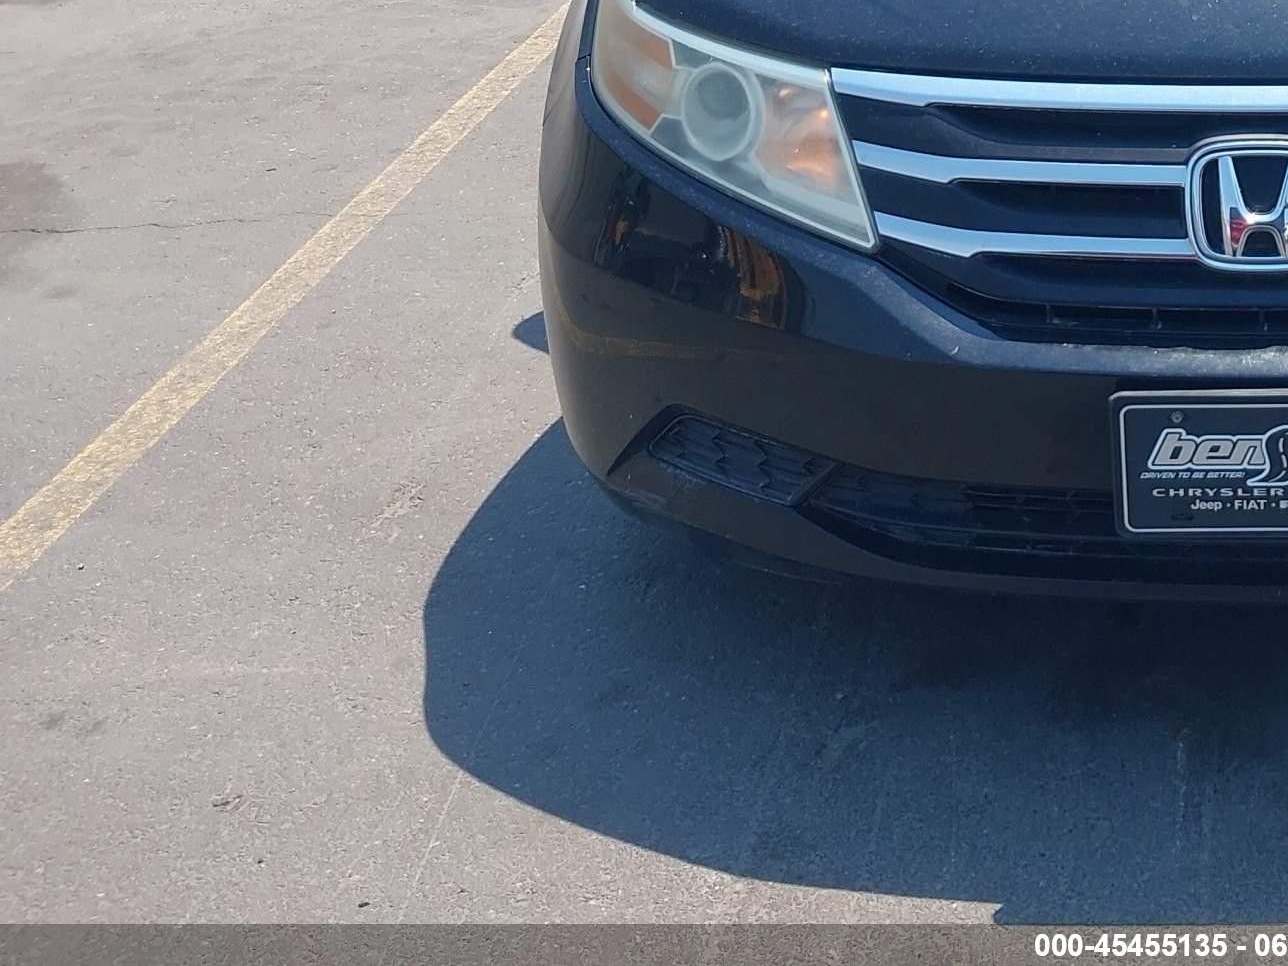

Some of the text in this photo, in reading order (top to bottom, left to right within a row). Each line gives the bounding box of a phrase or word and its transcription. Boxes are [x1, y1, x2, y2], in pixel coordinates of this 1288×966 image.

[1140, 471, 1176, 479] DRIVEN
[1191, 471, 1206, 479] BE
[1151, 488, 1284, 497] CHRYSLER
[1190, 499, 1222, 511] Jeep
[1234, 499, 1267, 509] FIAT
